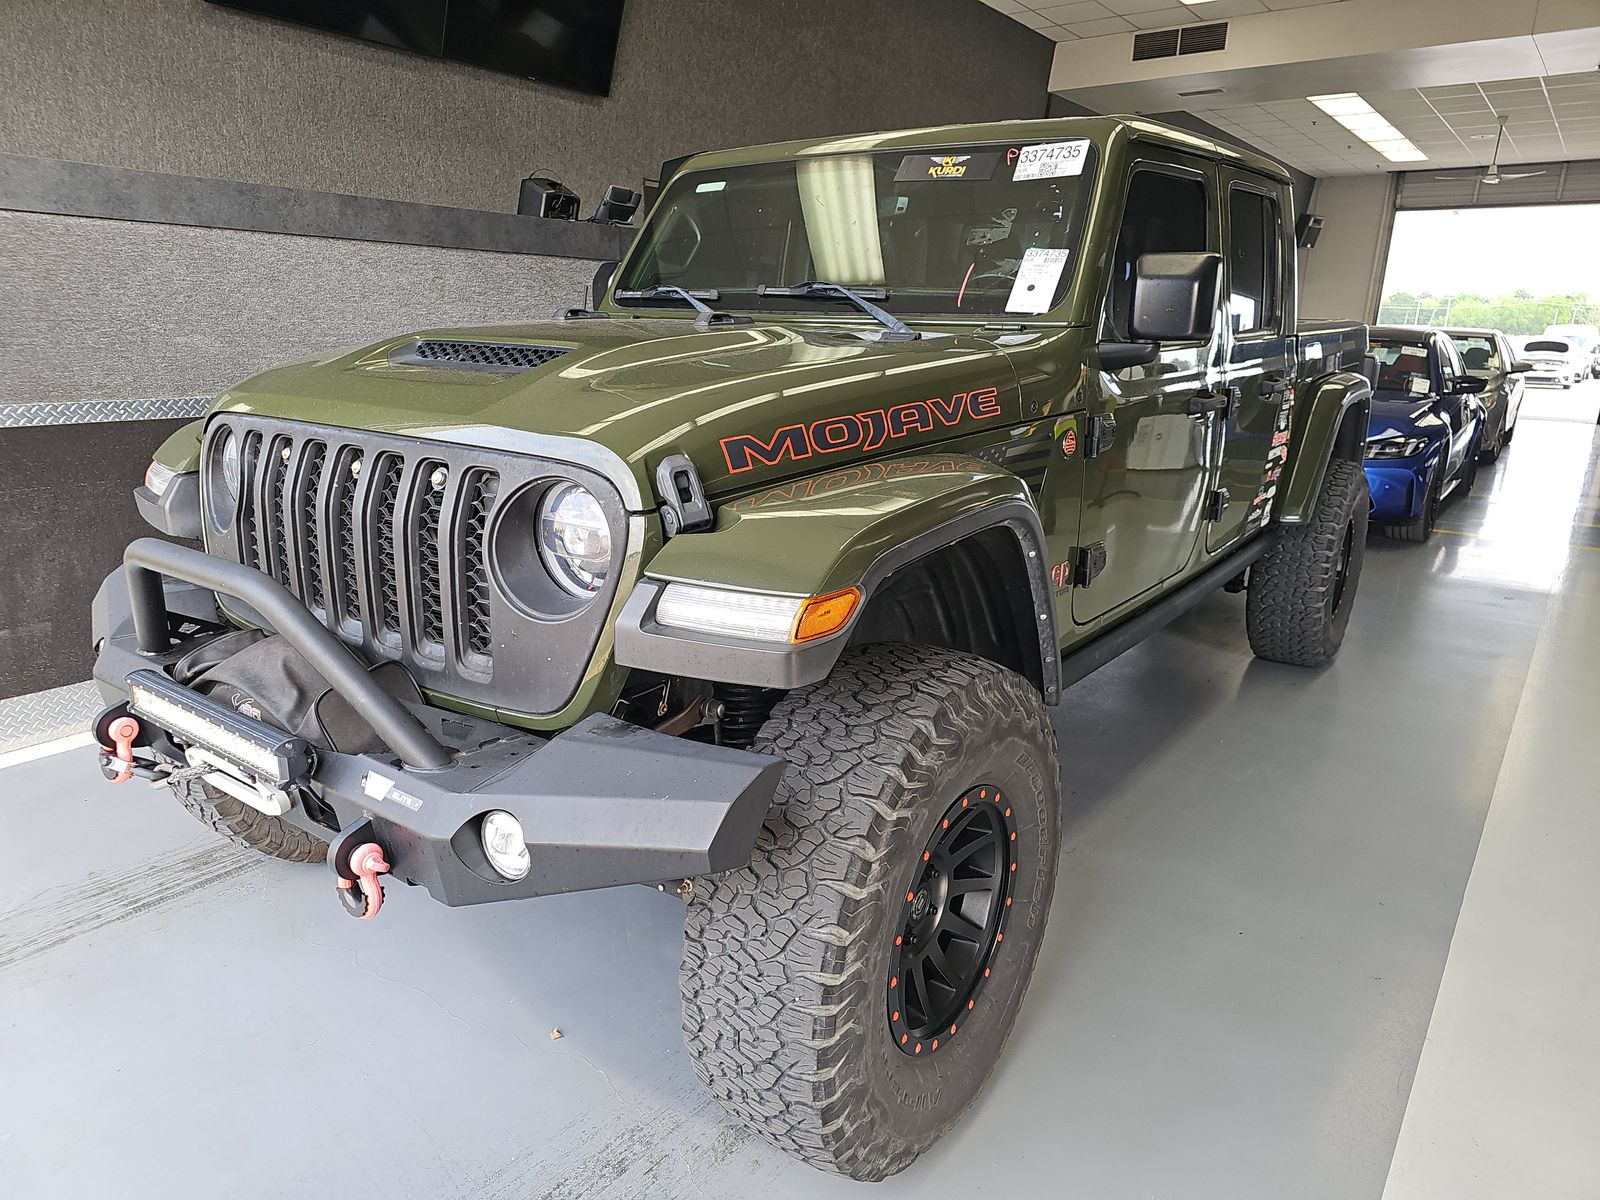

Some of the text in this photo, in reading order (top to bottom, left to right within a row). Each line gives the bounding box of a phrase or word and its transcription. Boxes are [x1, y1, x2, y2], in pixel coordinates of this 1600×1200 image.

[1020, 144, 1082, 164] 3374735
[928, 165, 967, 178] KURDI
[1026, 249, 1068, 258] 3374735
[719, 387, 1002, 475] MOJAVE
